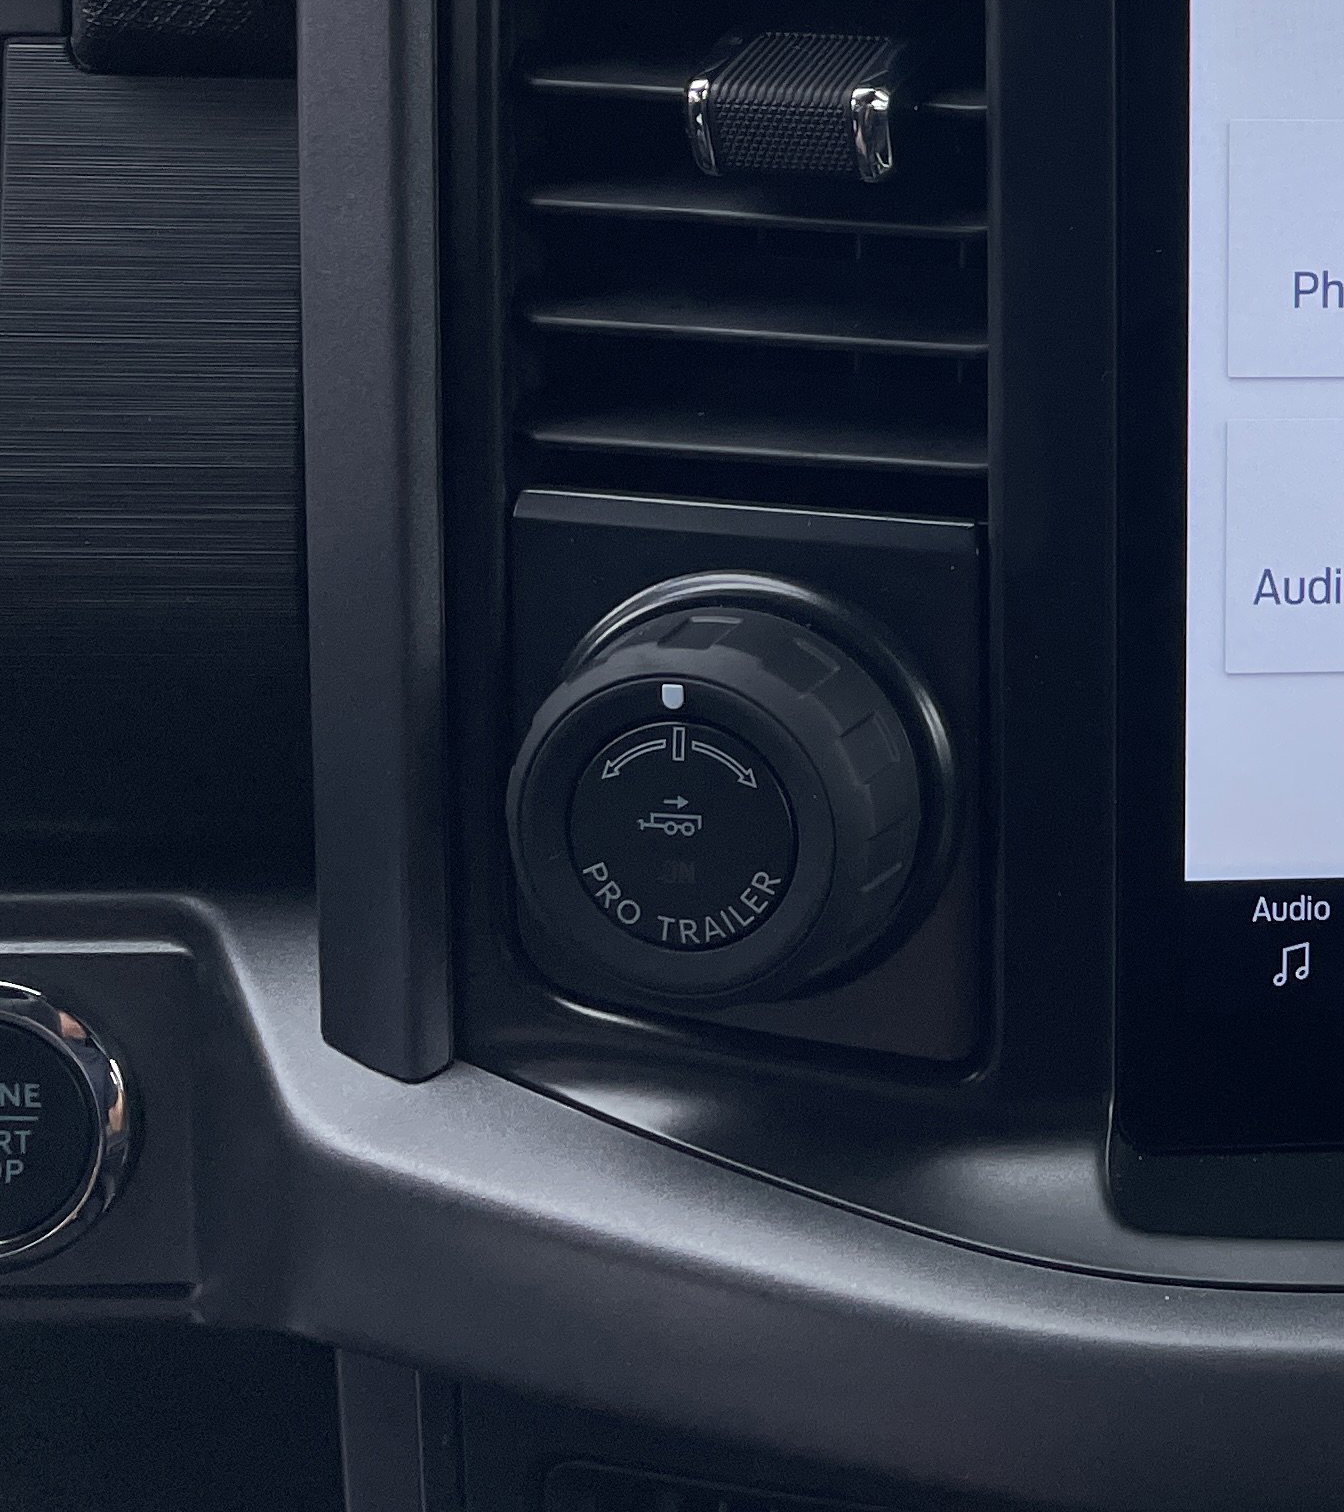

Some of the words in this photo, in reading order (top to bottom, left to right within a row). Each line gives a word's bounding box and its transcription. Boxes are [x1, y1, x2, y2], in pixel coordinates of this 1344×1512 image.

[582, 860, 642, 924] PRO
[657, 870, 782, 944] TRAILER
[1251, 894, 1331, 923] Audio
